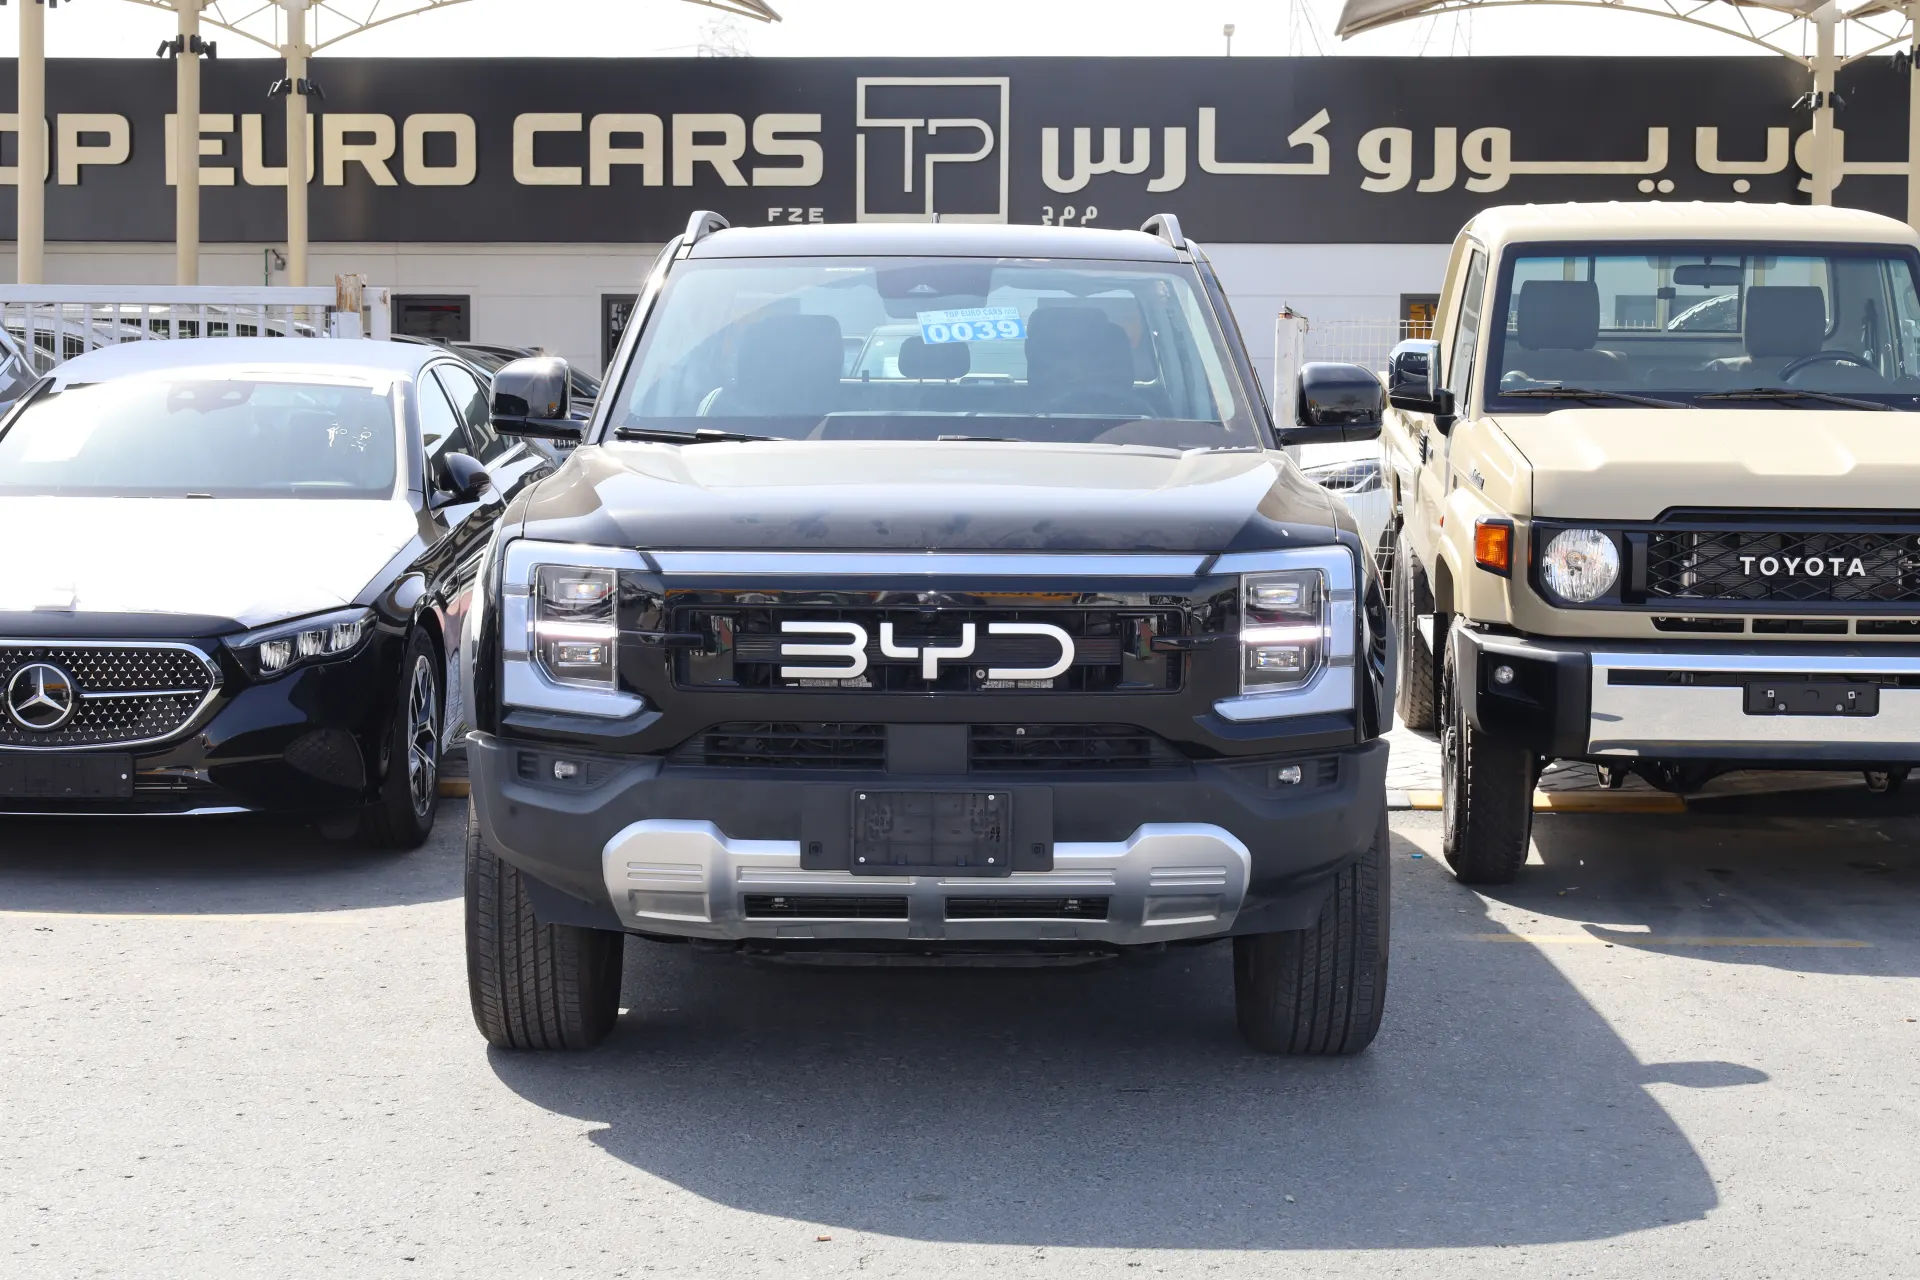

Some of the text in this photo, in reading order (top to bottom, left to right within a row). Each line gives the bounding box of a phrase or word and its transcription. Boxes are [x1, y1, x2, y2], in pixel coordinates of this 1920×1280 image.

[164, 113, 477, 187] EURO
[512, 112, 825, 187] CARS
[767, 208, 826, 231] FZE
[961, 309, 980, 317] EURO
[982, 308, 1003, 316] CARS
[927, 320, 1020, 342] 0039
[1739, 556, 1867, 577] TOYOTA
[781, 621, 1076, 680] BYD
